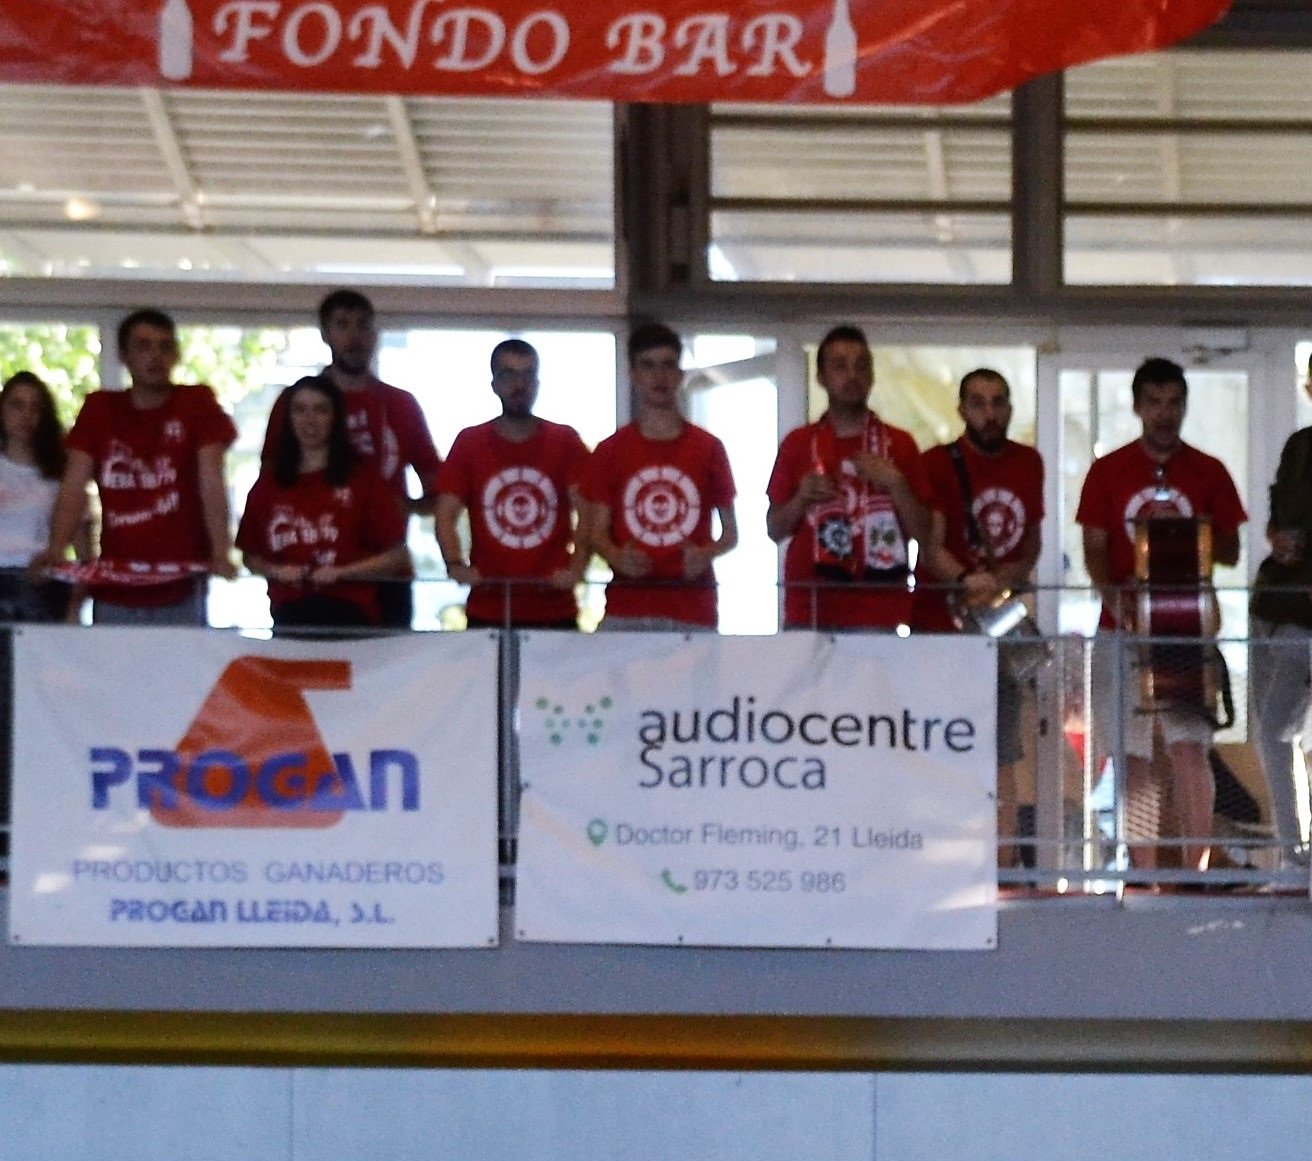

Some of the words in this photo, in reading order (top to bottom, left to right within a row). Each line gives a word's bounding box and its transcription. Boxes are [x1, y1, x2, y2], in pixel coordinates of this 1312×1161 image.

[213, 0, 571, 73] FONDO
[607, 12, 812, 77] BAR
[638, 696, 976, 753] audiocentre
[88, 746, 422, 812] PROGAN
[638, 742, 827, 790] Sarroca
[616, 823, 692, 846] Doctor
[813, 824, 841, 848] 21
[853, 826, 924, 851] Lleida
[72, 859, 248, 884] PRODUCTOS
[265, 860, 445, 885] GANADEROS
[694, 869, 739, 892] 973
[747, 870, 792, 893] 525
[801, 871, 847, 894] 986
[110, 899, 229, 923] PROGAN
